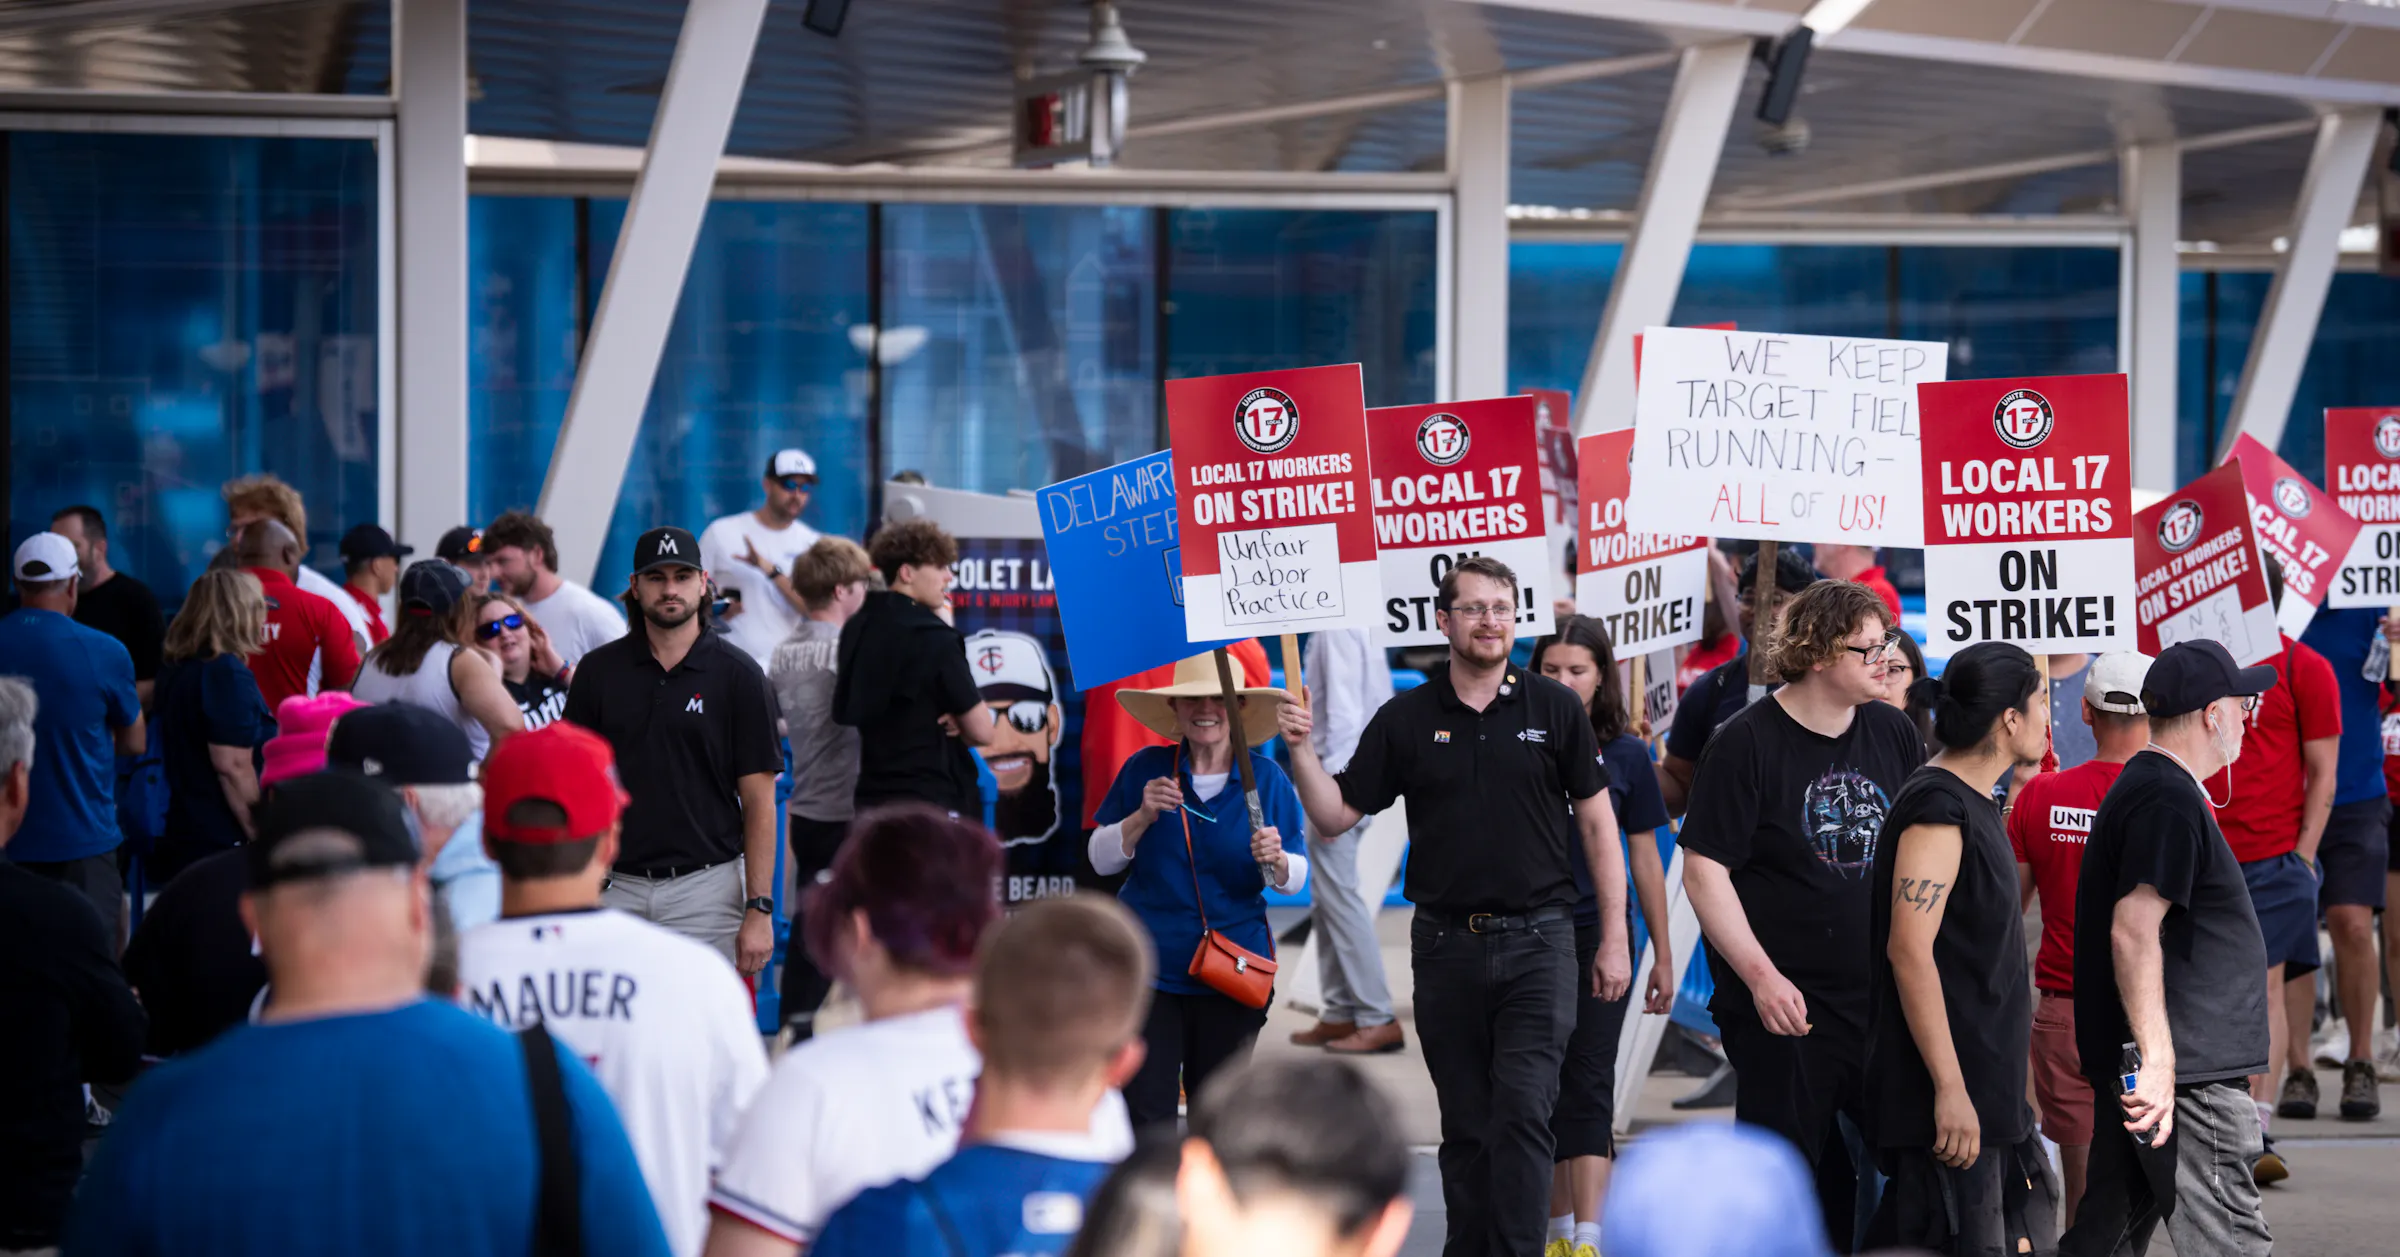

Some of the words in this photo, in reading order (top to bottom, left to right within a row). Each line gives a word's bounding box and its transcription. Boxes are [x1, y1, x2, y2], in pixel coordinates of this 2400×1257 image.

[1725, 335, 1790, 378] WE
[1828, 340, 1926, 386] KEEP
[1248, 406, 1283, 438] 17
[1676, 379, 1828, 421] TARGET
[1852, 393, 1920, 441] FIEL
[2006, 407, 2039, 434] 17
[1428, 429, 1457, 453] 17
[1190, 463, 1246, 486] LOCAL
[1247, 461, 1264, 481] 17
[1267, 453, 1353, 480] WORKERS
[1372, 469, 1485, 508] LOCAL
[1488, 466, 1522, 498] 17
[1941, 457, 2066, 495] LOCAL
[2072, 455, 2110, 490] 17
[2337, 463, 2400, 492] LOCA
[1193, 491, 1236, 526] ON
[1241, 480, 1356, 522] STRIKE!
[1710, 482, 1780, 526] ALL
[1790, 491, 1824, 519] OF
[1838, 494, 1886, 531] US!
[1941, 497, 2113, 538] WORKERS
[1375, 503, 1528, 545] WORKERS
[2168, 511, 2192, 542] 17
[1222, 530, 1310, 561] Unfair
[2135, 565, 2171, 598] LOCAL
[2170, 557, 2183, 577] 17
[2183, 525, 2243, 570] WORKERS
[2300, 540, 2330, 571] 17
[1231, 559, 1311, 587] Labor
[1430, 551, 1480, 589] O
[1624, 565, 1662, 605] ON
[1999, 549, 2058, 592] ON
[2138, 590, 2168, 626] ON
[2168, 546, 2250, 610] STRIKE!
[1226, 588, 1337, 616] Practice
[1600, 596, 1693, 648] TRIKE!
[1946, 595, 2116, 642] STRIKE!
[2054, 810, 2096, 828] UNIT
[1008, 876, 1075, 901] BEARD
[470, 969, 637, 1027] MAUER
